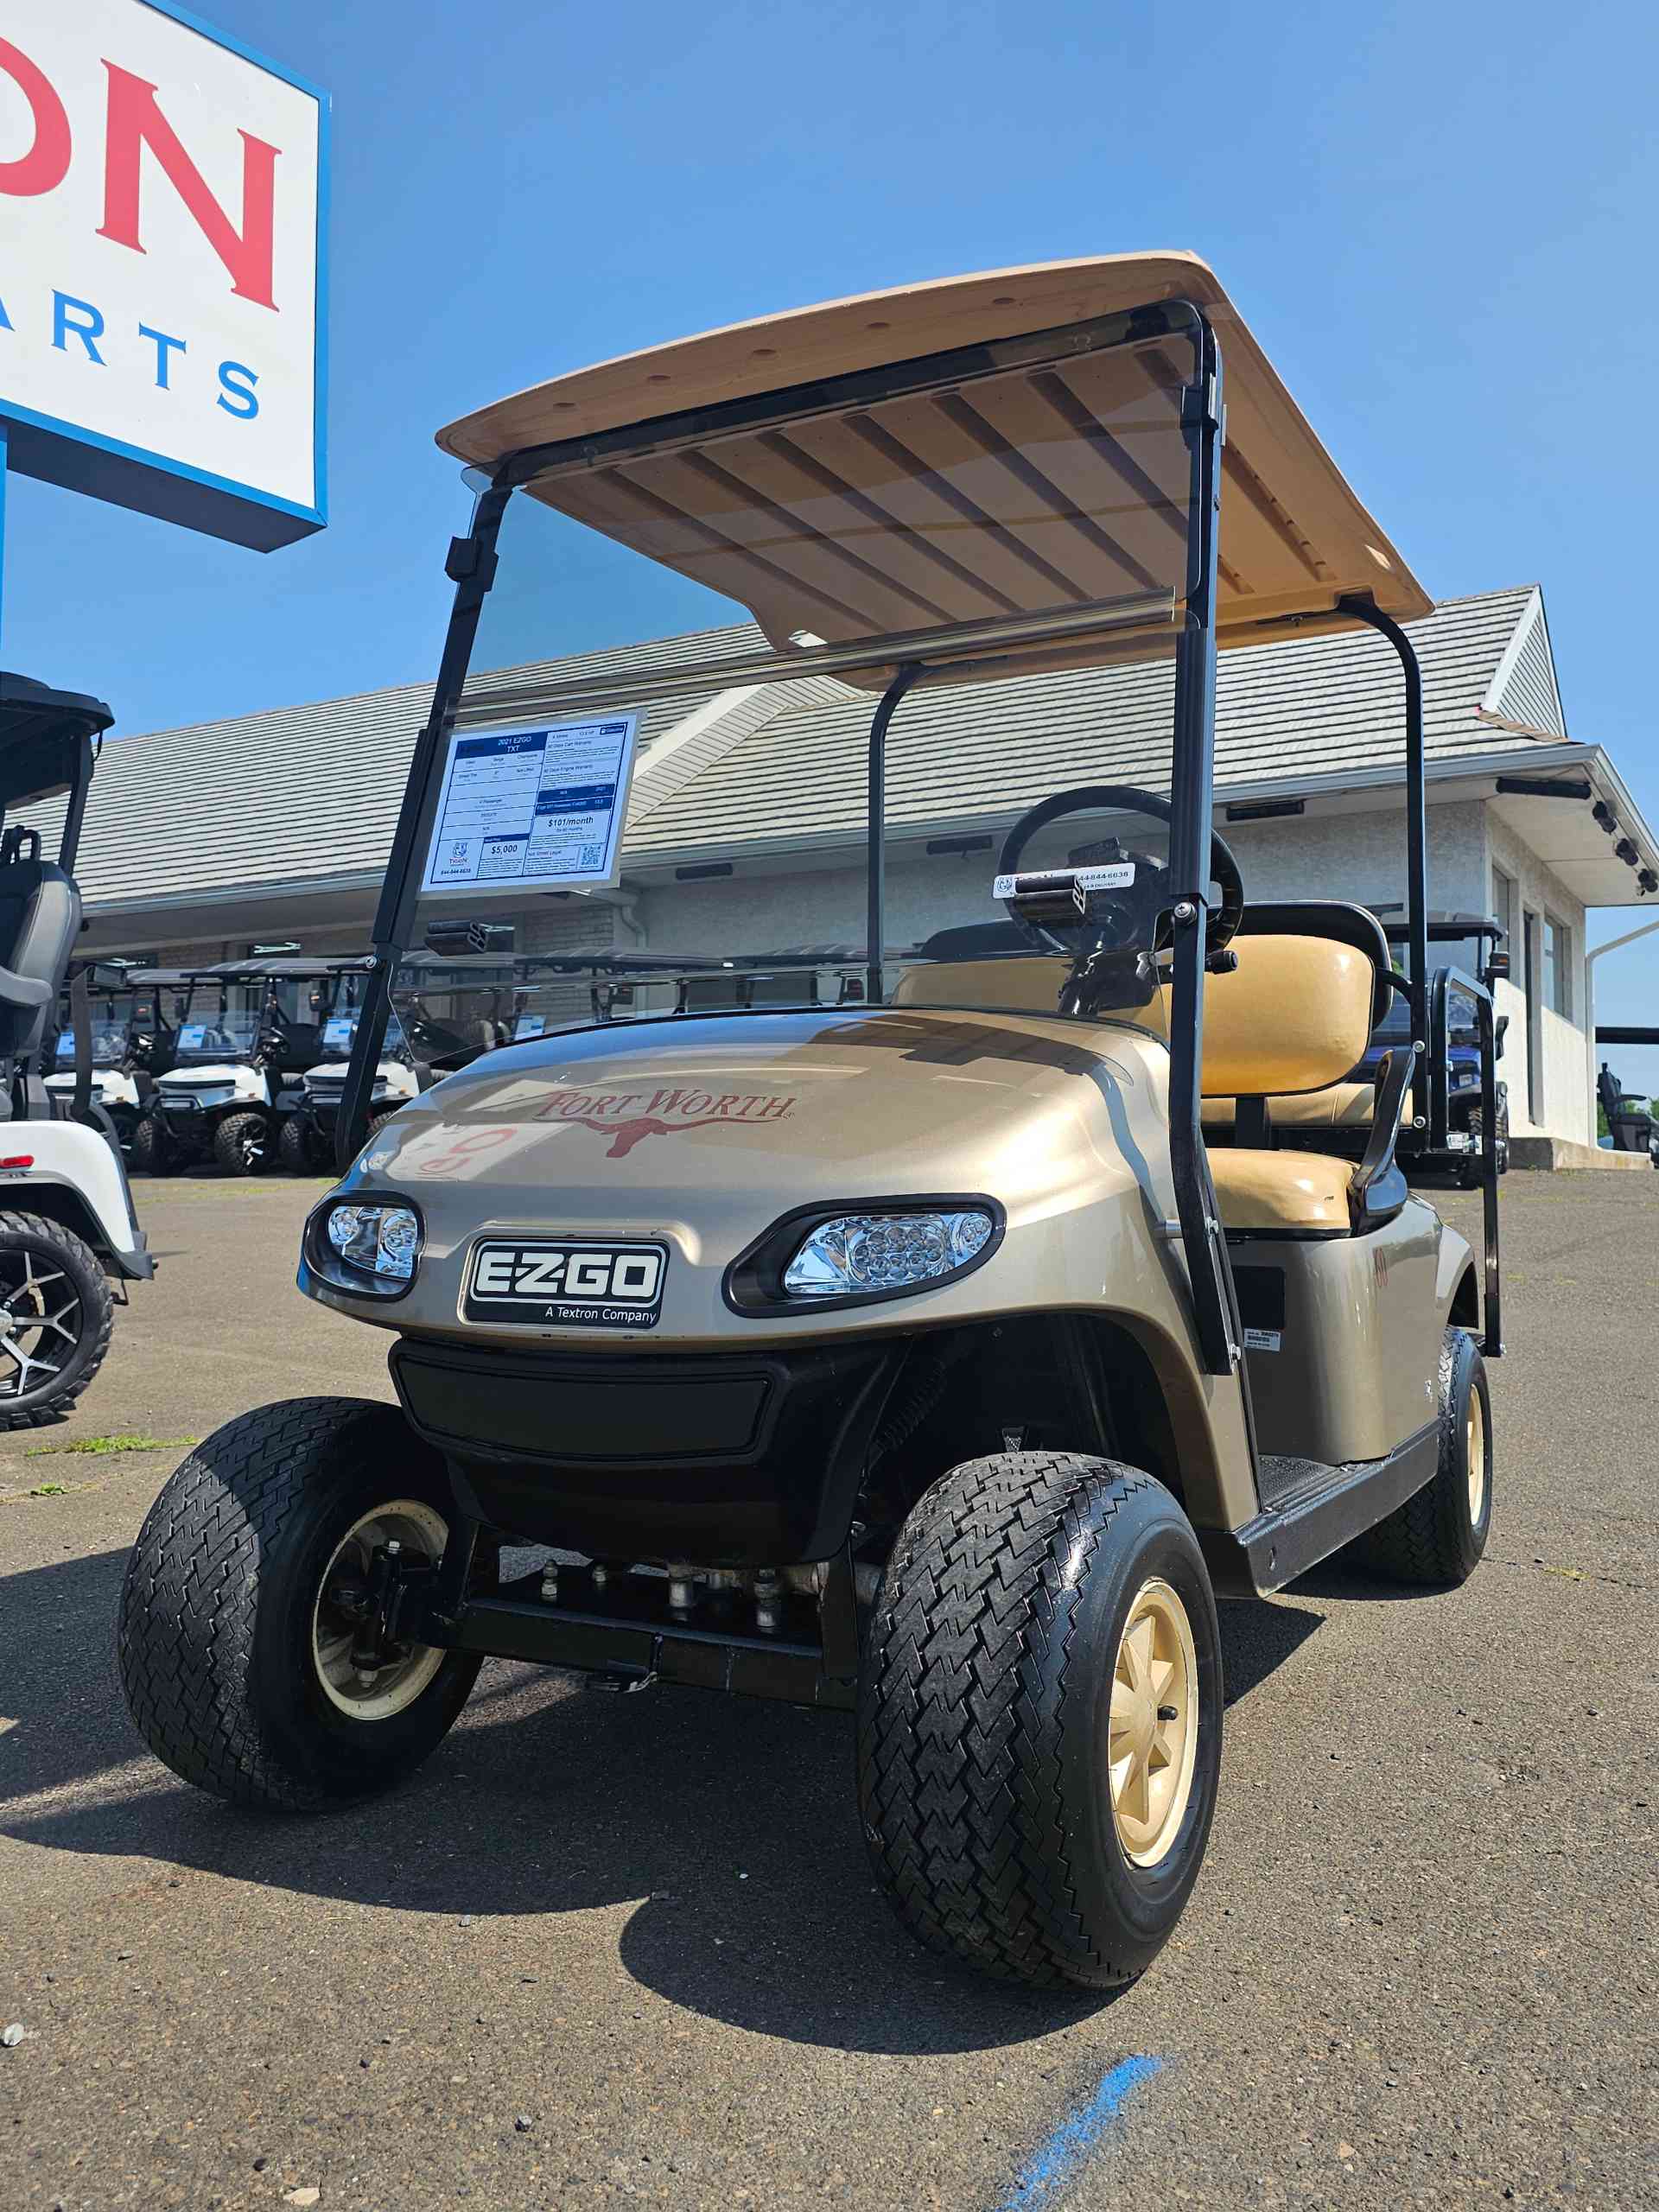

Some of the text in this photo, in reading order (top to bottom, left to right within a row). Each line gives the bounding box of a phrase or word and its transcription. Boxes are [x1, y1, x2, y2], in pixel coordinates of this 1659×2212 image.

[0, 289, 260, 421] RTS
[506, 745, 520, 753] TXT
[548, 816, 594, 828] $101/month
[491, 844, 518, 855] $5,000
[533, 1088, 797, 1118] FORT WORTH
[545, 1306, 657, 1324] A Textron Company
